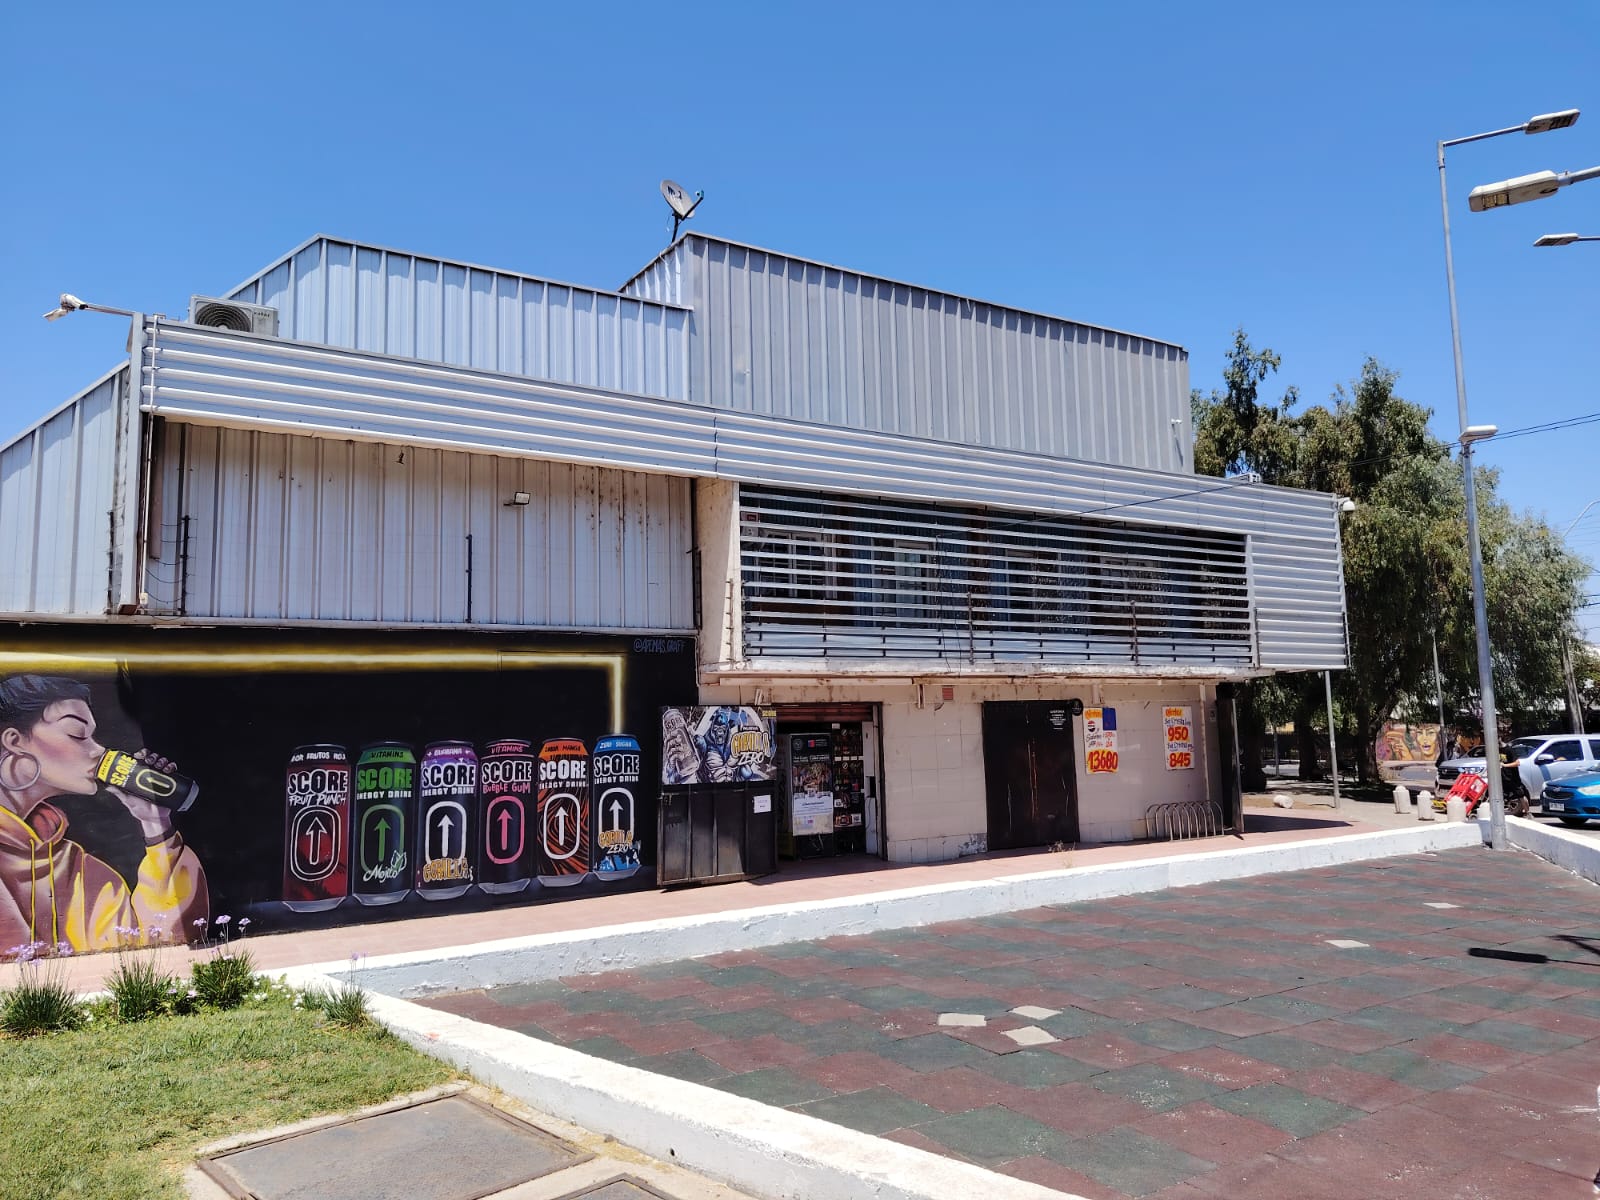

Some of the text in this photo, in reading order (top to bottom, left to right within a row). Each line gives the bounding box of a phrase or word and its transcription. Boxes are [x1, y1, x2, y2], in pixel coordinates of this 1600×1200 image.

[1168, 726, 1188, 741] 950
[491, 745, 524, 754] VITAMINS
[730, 731, 771, 759] GORILLA
[306, 752, 330, 760] FRUTOS
[738, 751, 765, 765] ZERO
[1088, 751, 1118, 770] 13680
[1169, 753, 1191, 767] 845
[110, 754, 137, 786] SCORE
[481, 760, 533, 784] SCORE
[539, 759, 586, 781] SCORE
[593, 754, 640, 777] SCORE
[287, 769, 348, 795] SCORE
[357, 767, 413, 790] SCORE
[421, 763, 476, 788] SCORE
[594, 775, 639, 785] ENERGY DRINK
[422, 786, 474, 797] ENERGY DRINK
[482, 782, 531, 794] BUBBLE GUM
[539, 781, 563, 790] ENERGY
[289, 793, 346, 806] FRUIT PUNCH
[357, 790, 412, 800] ENERGY DRINK
[607, 844, 629, 854] ZERO
[423, 857, 470, 883] GORILLA
